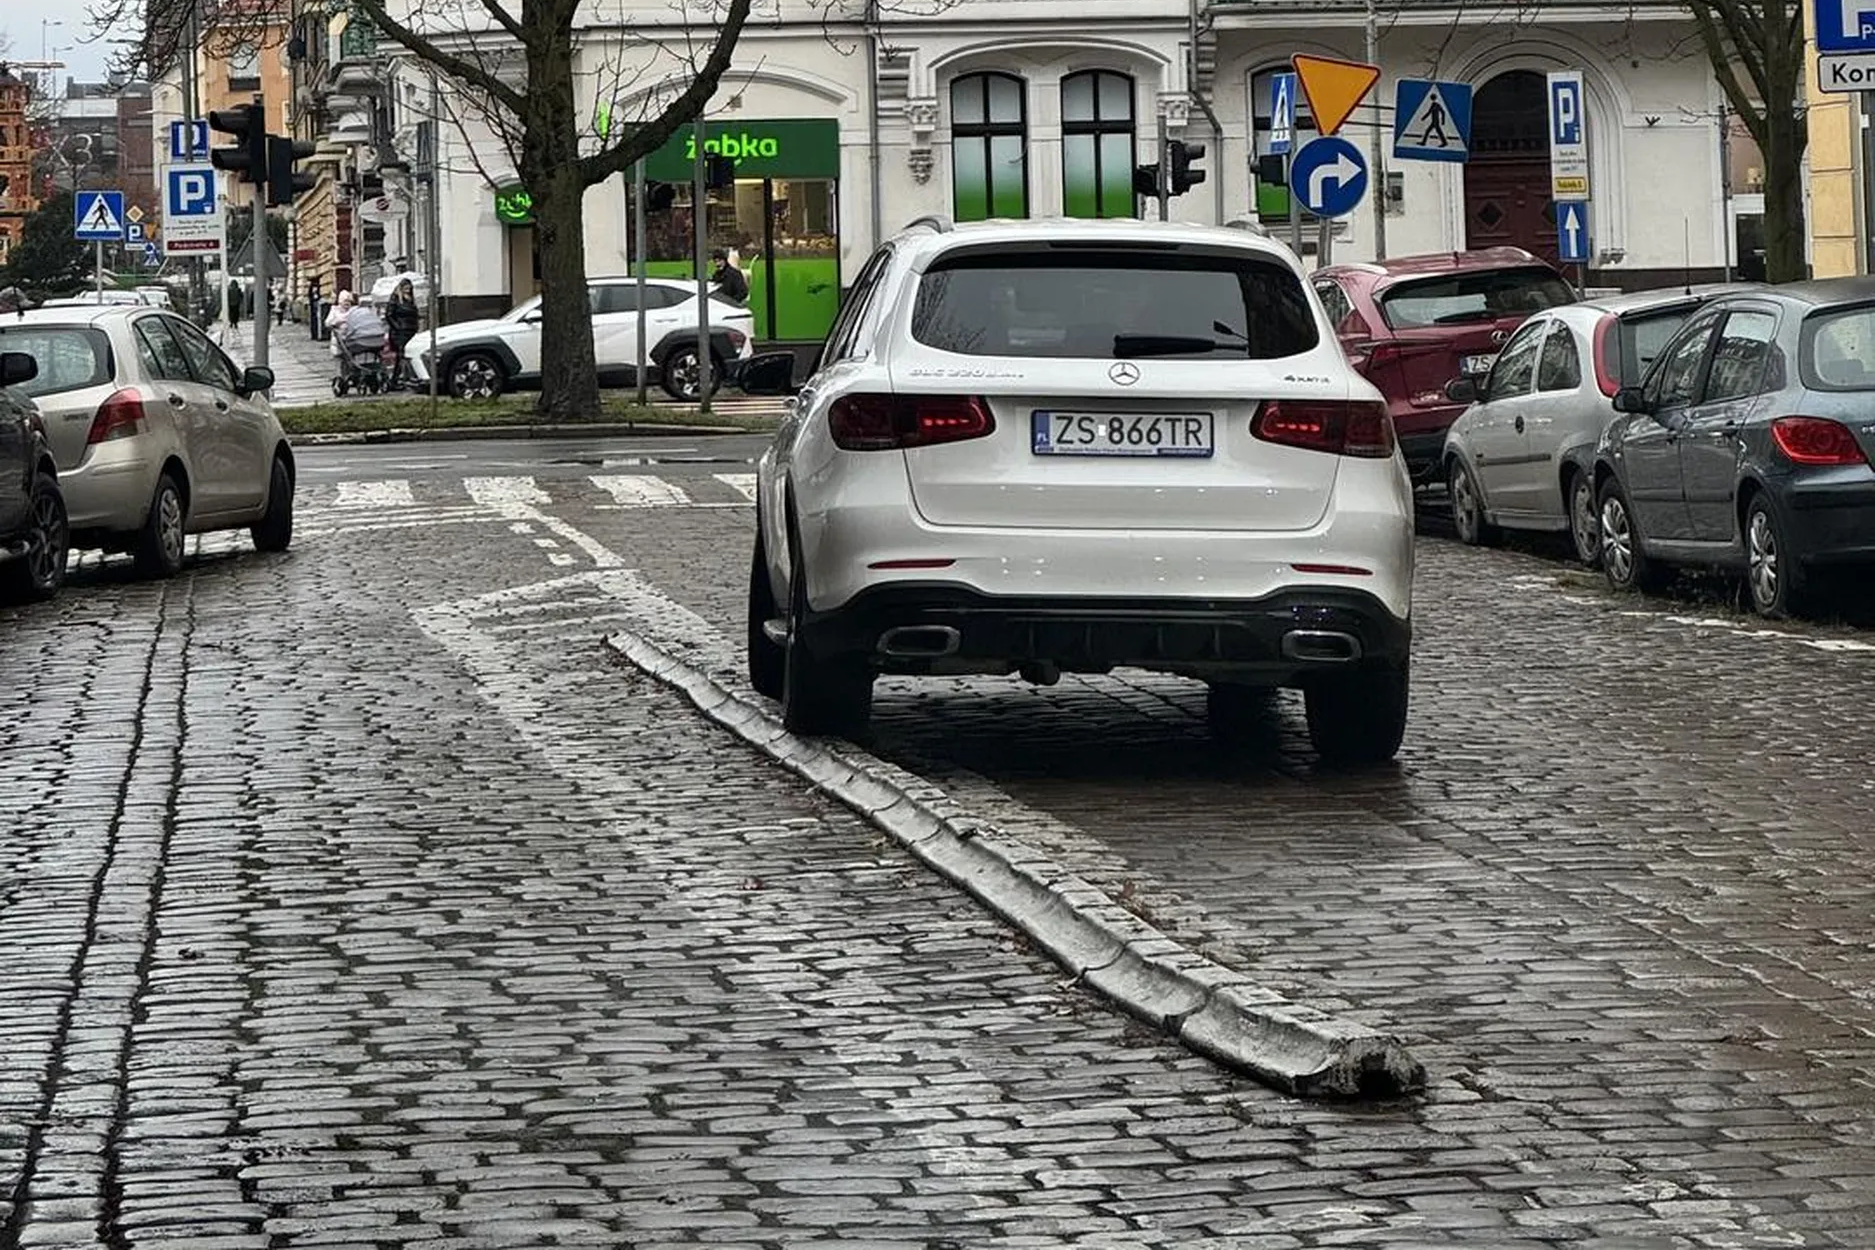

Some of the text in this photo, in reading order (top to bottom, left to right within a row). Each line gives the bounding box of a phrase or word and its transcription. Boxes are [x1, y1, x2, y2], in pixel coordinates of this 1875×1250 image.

[179, 174, 206, 211] P
[1055, 416, 1204, 447] ZS 866TR
